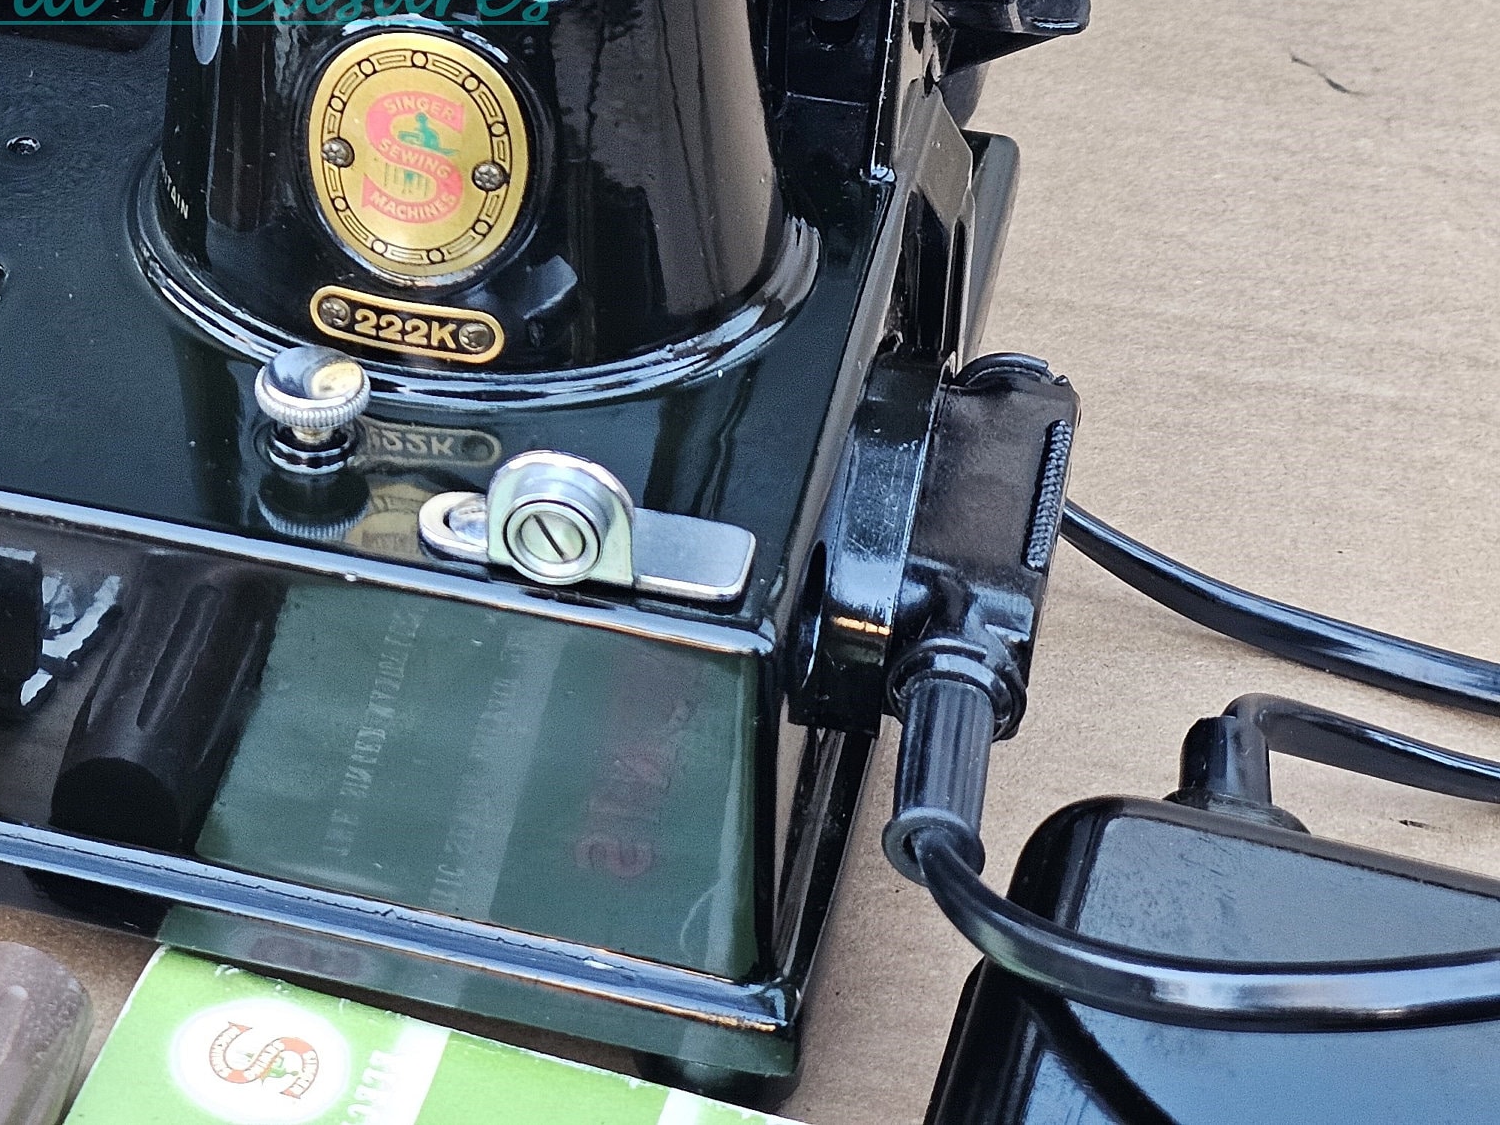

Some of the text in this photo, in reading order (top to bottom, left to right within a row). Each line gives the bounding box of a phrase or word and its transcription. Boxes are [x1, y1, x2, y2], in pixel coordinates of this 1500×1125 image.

[382, 94, 456, 122] SINGER
[378, 137, 452, 180] SEWING
[369, 190, 457, 221] MACHINES
[353, 307, 460, 351] 222K
